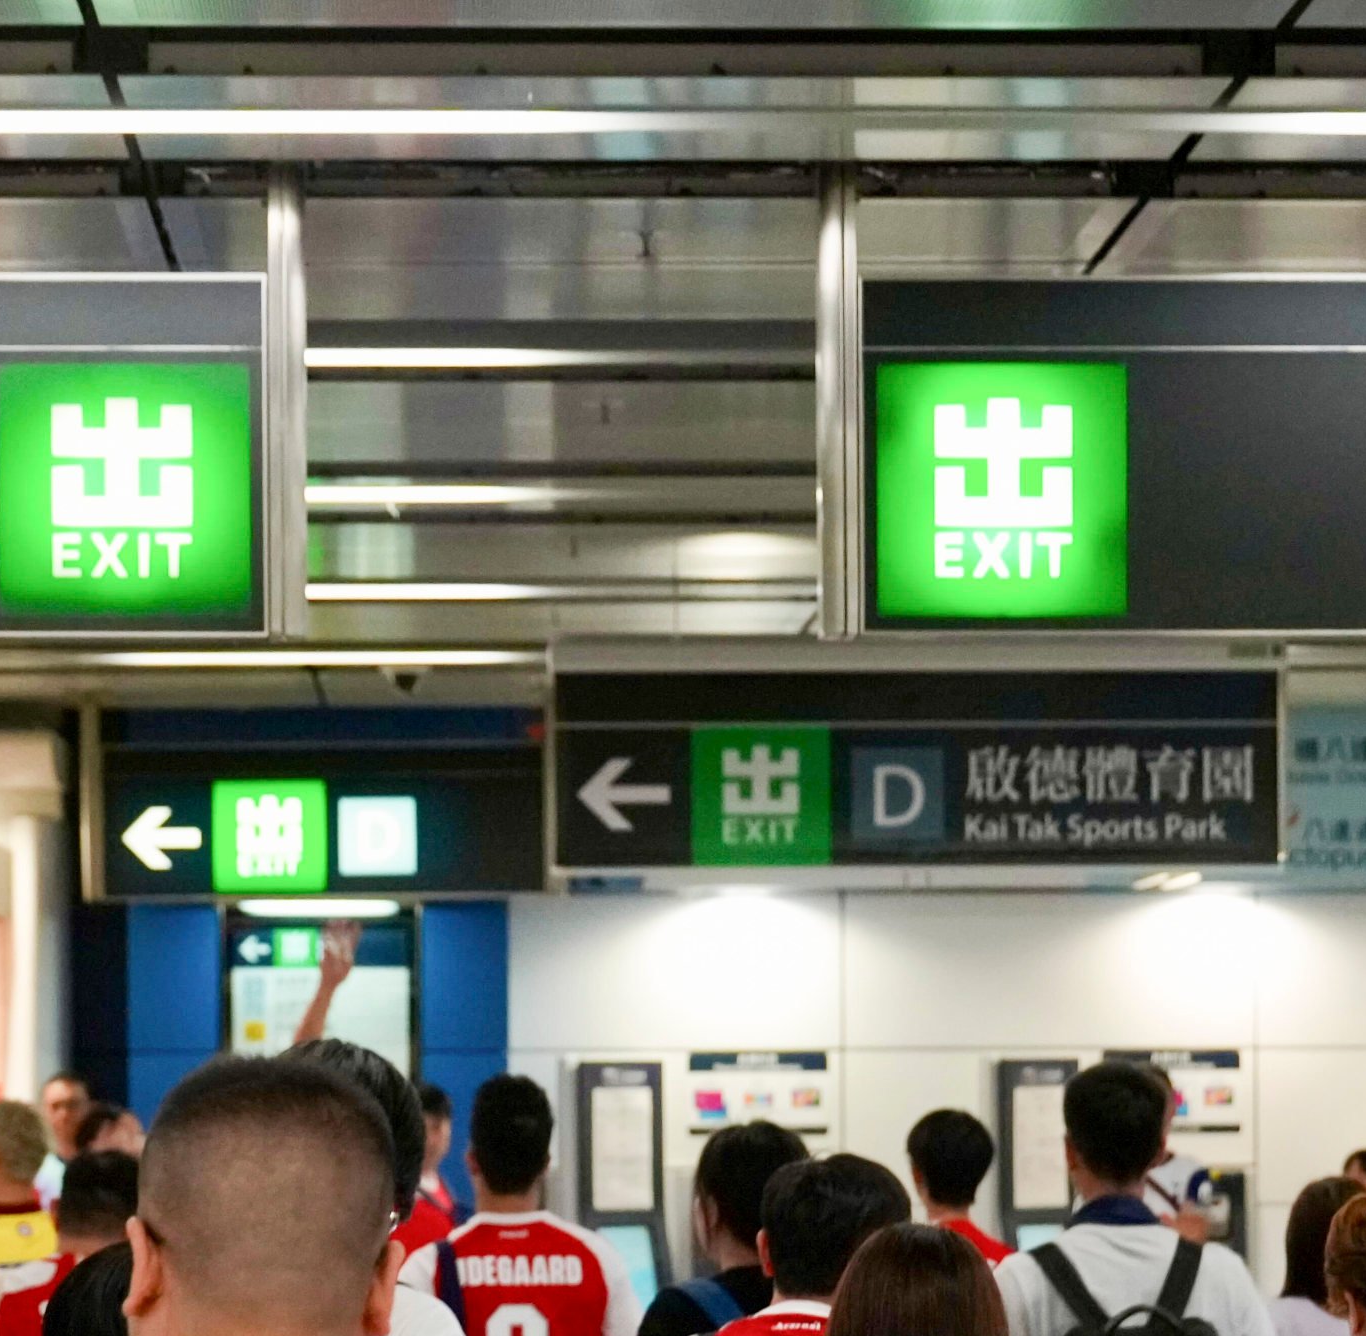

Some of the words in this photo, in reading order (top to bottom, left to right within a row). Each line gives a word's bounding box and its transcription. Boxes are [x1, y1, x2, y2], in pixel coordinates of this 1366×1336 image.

[50, 532, 194, 580] EXIT
[933, 532, 1074, 580] EXIT
[873, 763, 926, 828] D
[356, 809, 402, 866] D
[721, 818, 800, 845] EXIT
[964, 812, 1011, 842] Kai
[1013, 812, 1062, 842] Tak
[1065, 812, 1159, 848] Sports
[1164, 812, 1227, 842] Park
[236, 851, 303, 879] EXIT
